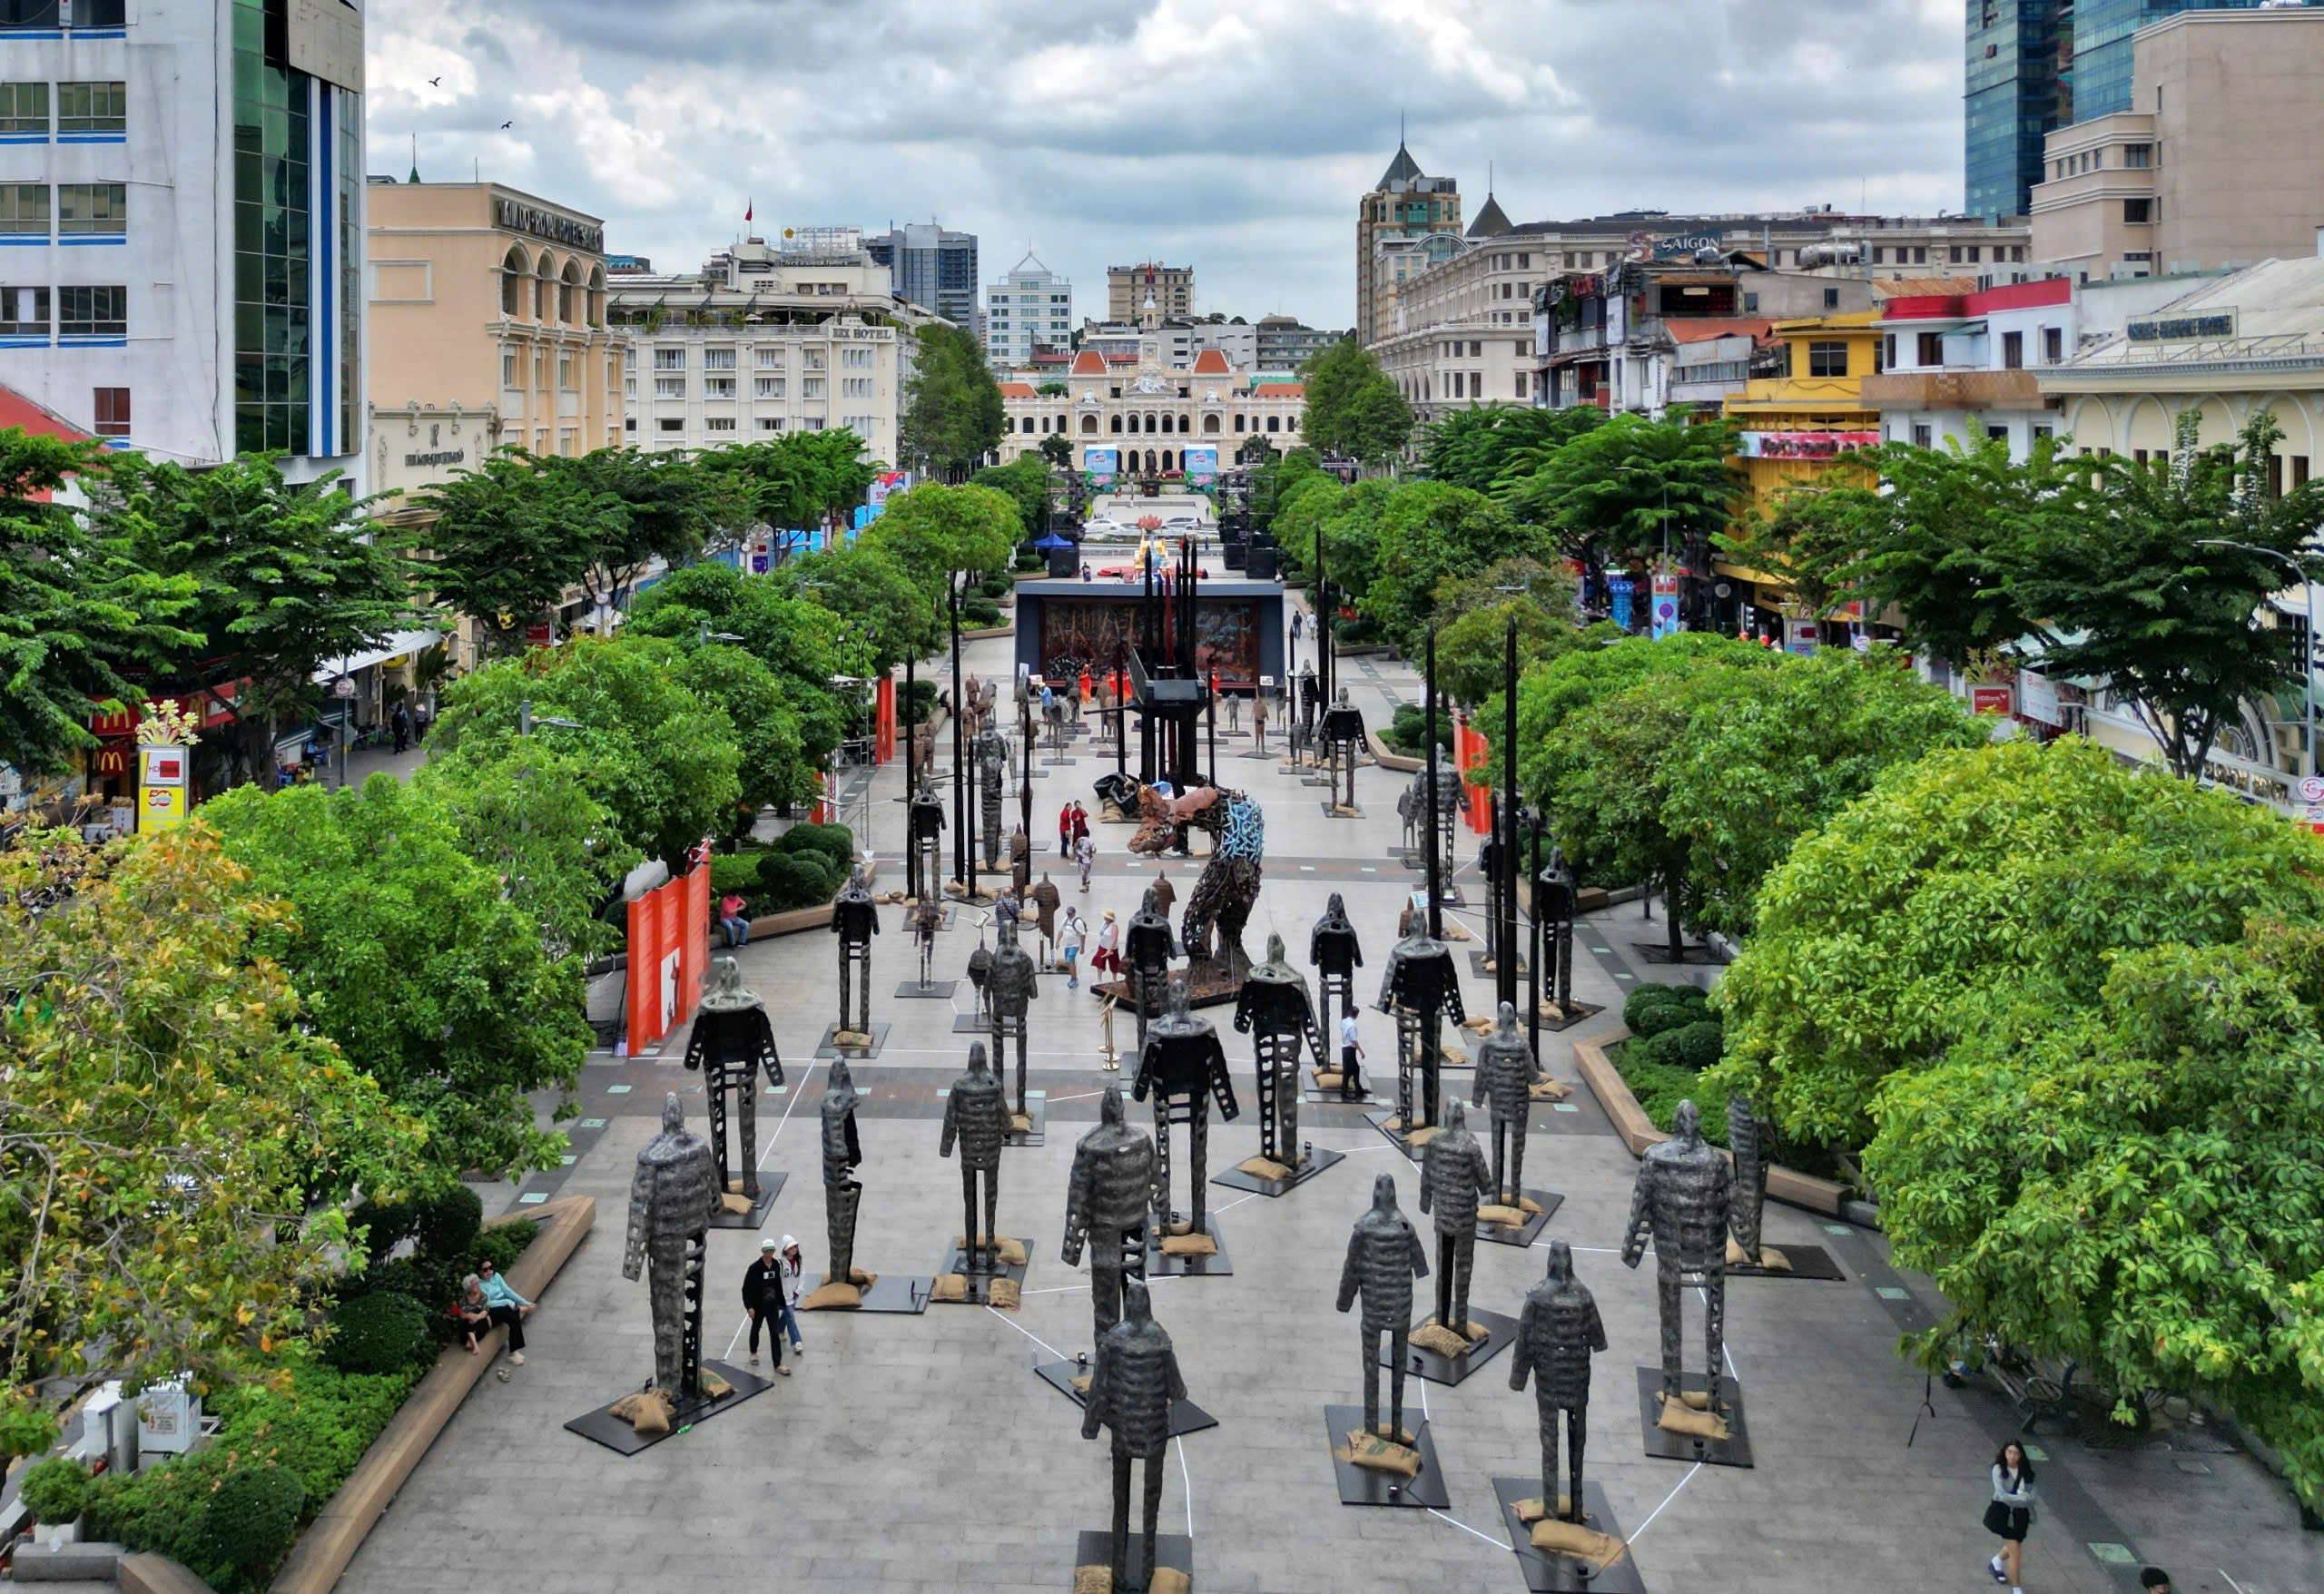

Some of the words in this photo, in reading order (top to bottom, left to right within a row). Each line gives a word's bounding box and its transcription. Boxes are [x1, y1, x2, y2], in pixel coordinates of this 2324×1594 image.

[1661, 237, 1720, 251] SAIGON
[832, 328, 851, 339] REX
[853, 328, 891, 339] HOTEL
